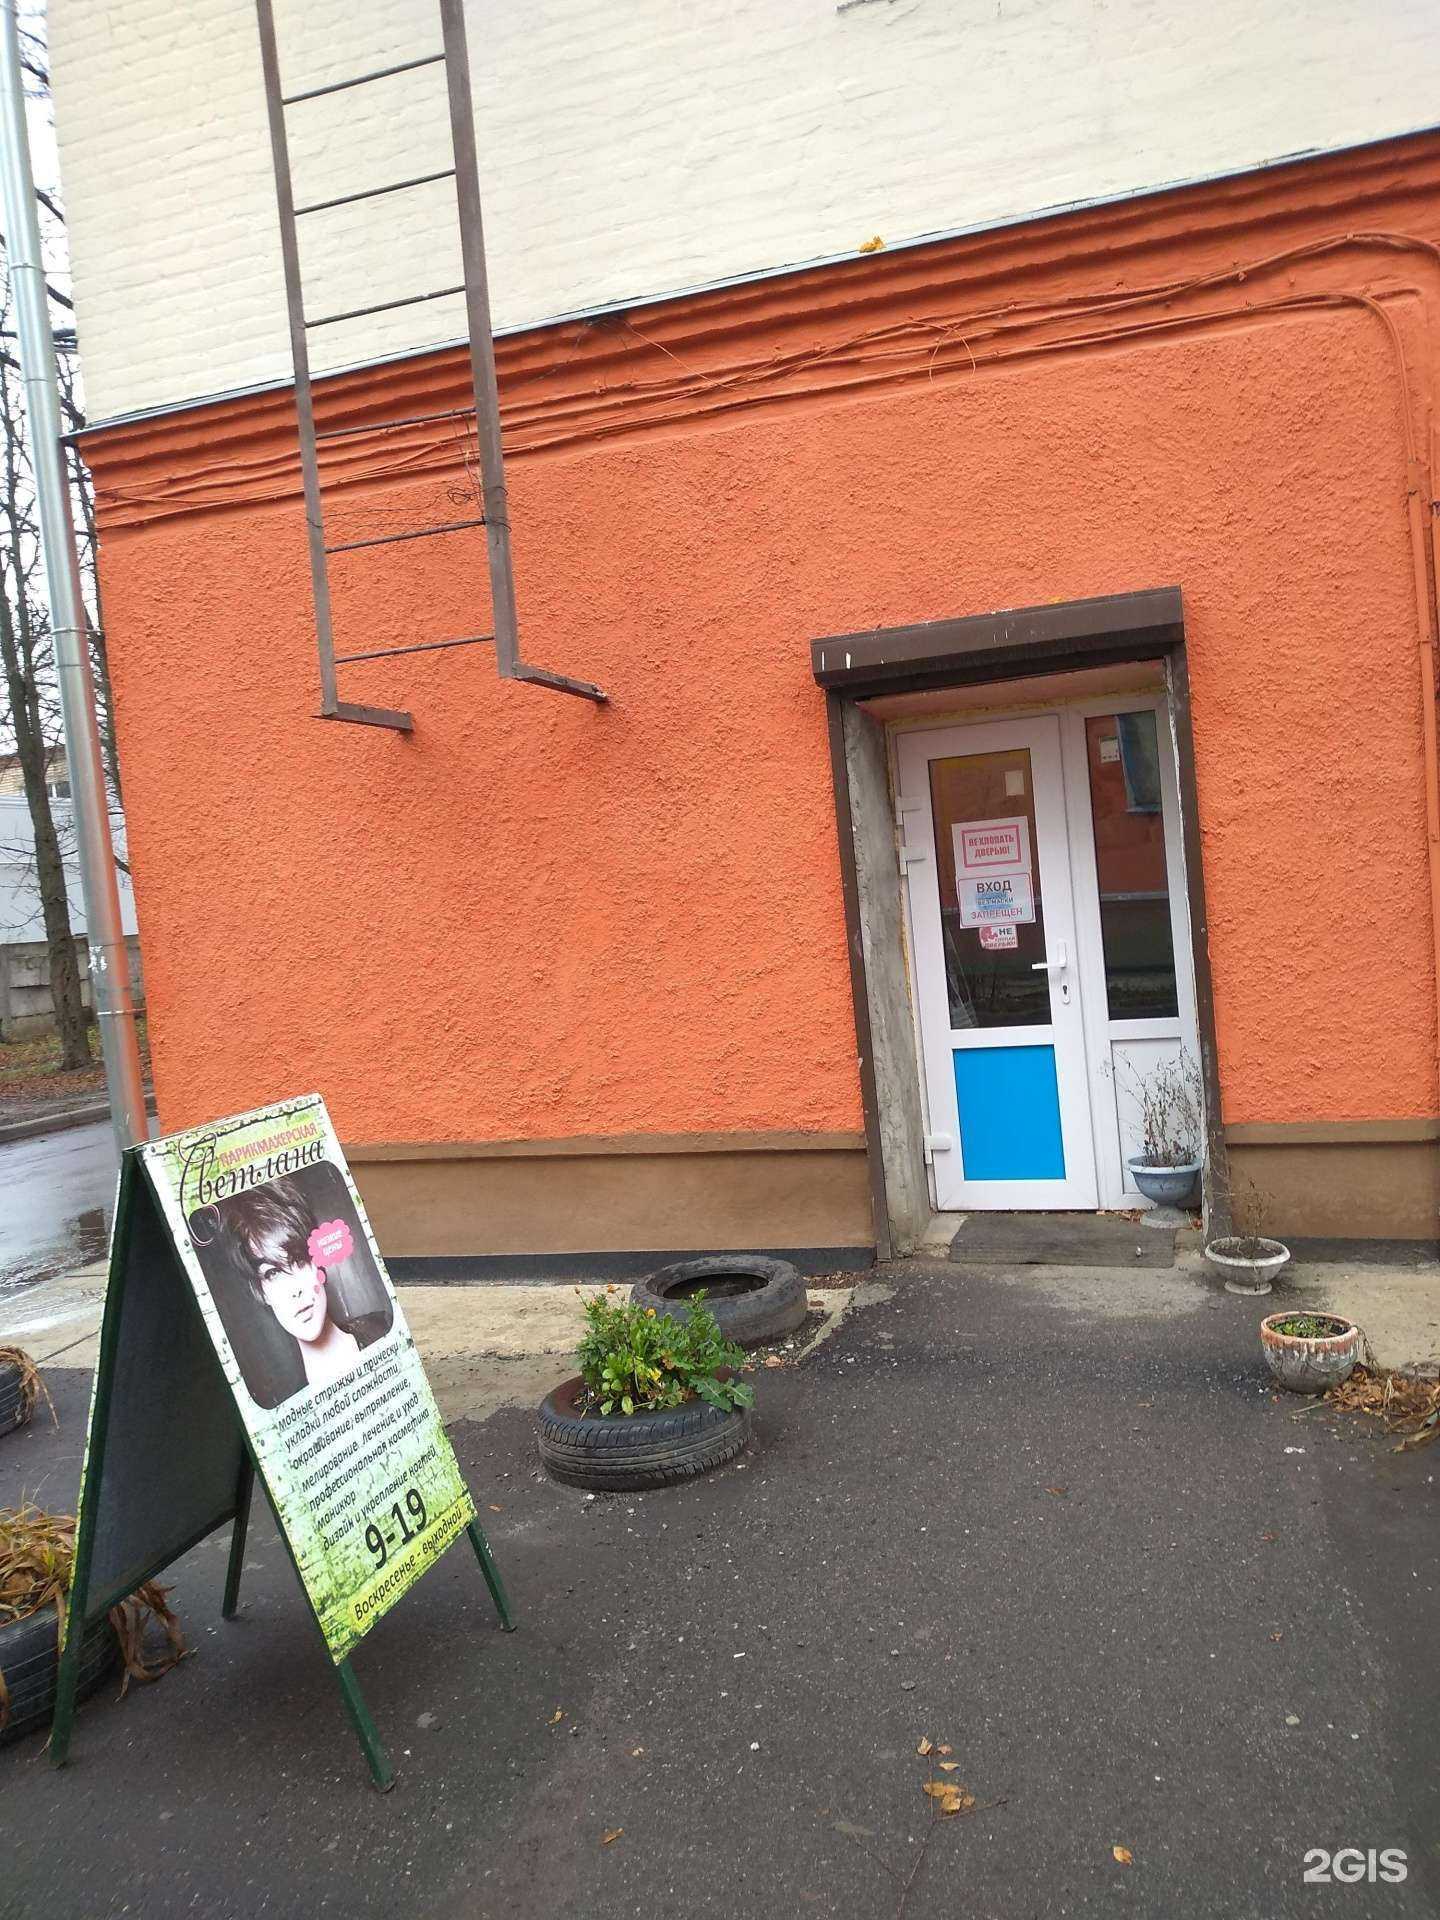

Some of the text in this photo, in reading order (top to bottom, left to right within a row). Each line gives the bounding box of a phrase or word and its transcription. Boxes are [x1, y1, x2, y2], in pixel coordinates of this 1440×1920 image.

[971, 907, 1023, 919] ЗАПРЕЩЕН
[977, 880, 1012, 894] ВХОД
[999, 927, 1013, 935] НЕ
[220, 1122, 318, 1167] ПАРИКМАХЕРСКАЯ
[178, 1133, 324, 1242] Светлана
[277, 1342, 399, 1432] модные стрижки и прически
[285, 1363, 399, 1453] укладки любой сложности
[354, 1378, 411, 1424] выпрямление,
[395, 1408, 402, 1418] и
[402, 1392, 419, 1416] уход
[309, 1408, 430, 1512] профессиональная косметика
[317, 1490, 357, 1531] маникюр
[323, 1444, 436, 1551] дизайн и укрепление ногтей
[365, 1488, 427, 1570] 9-19
[354, 1555, 415, 1621] Воскресенье
[422, 1504, 462, 1554] выходной
